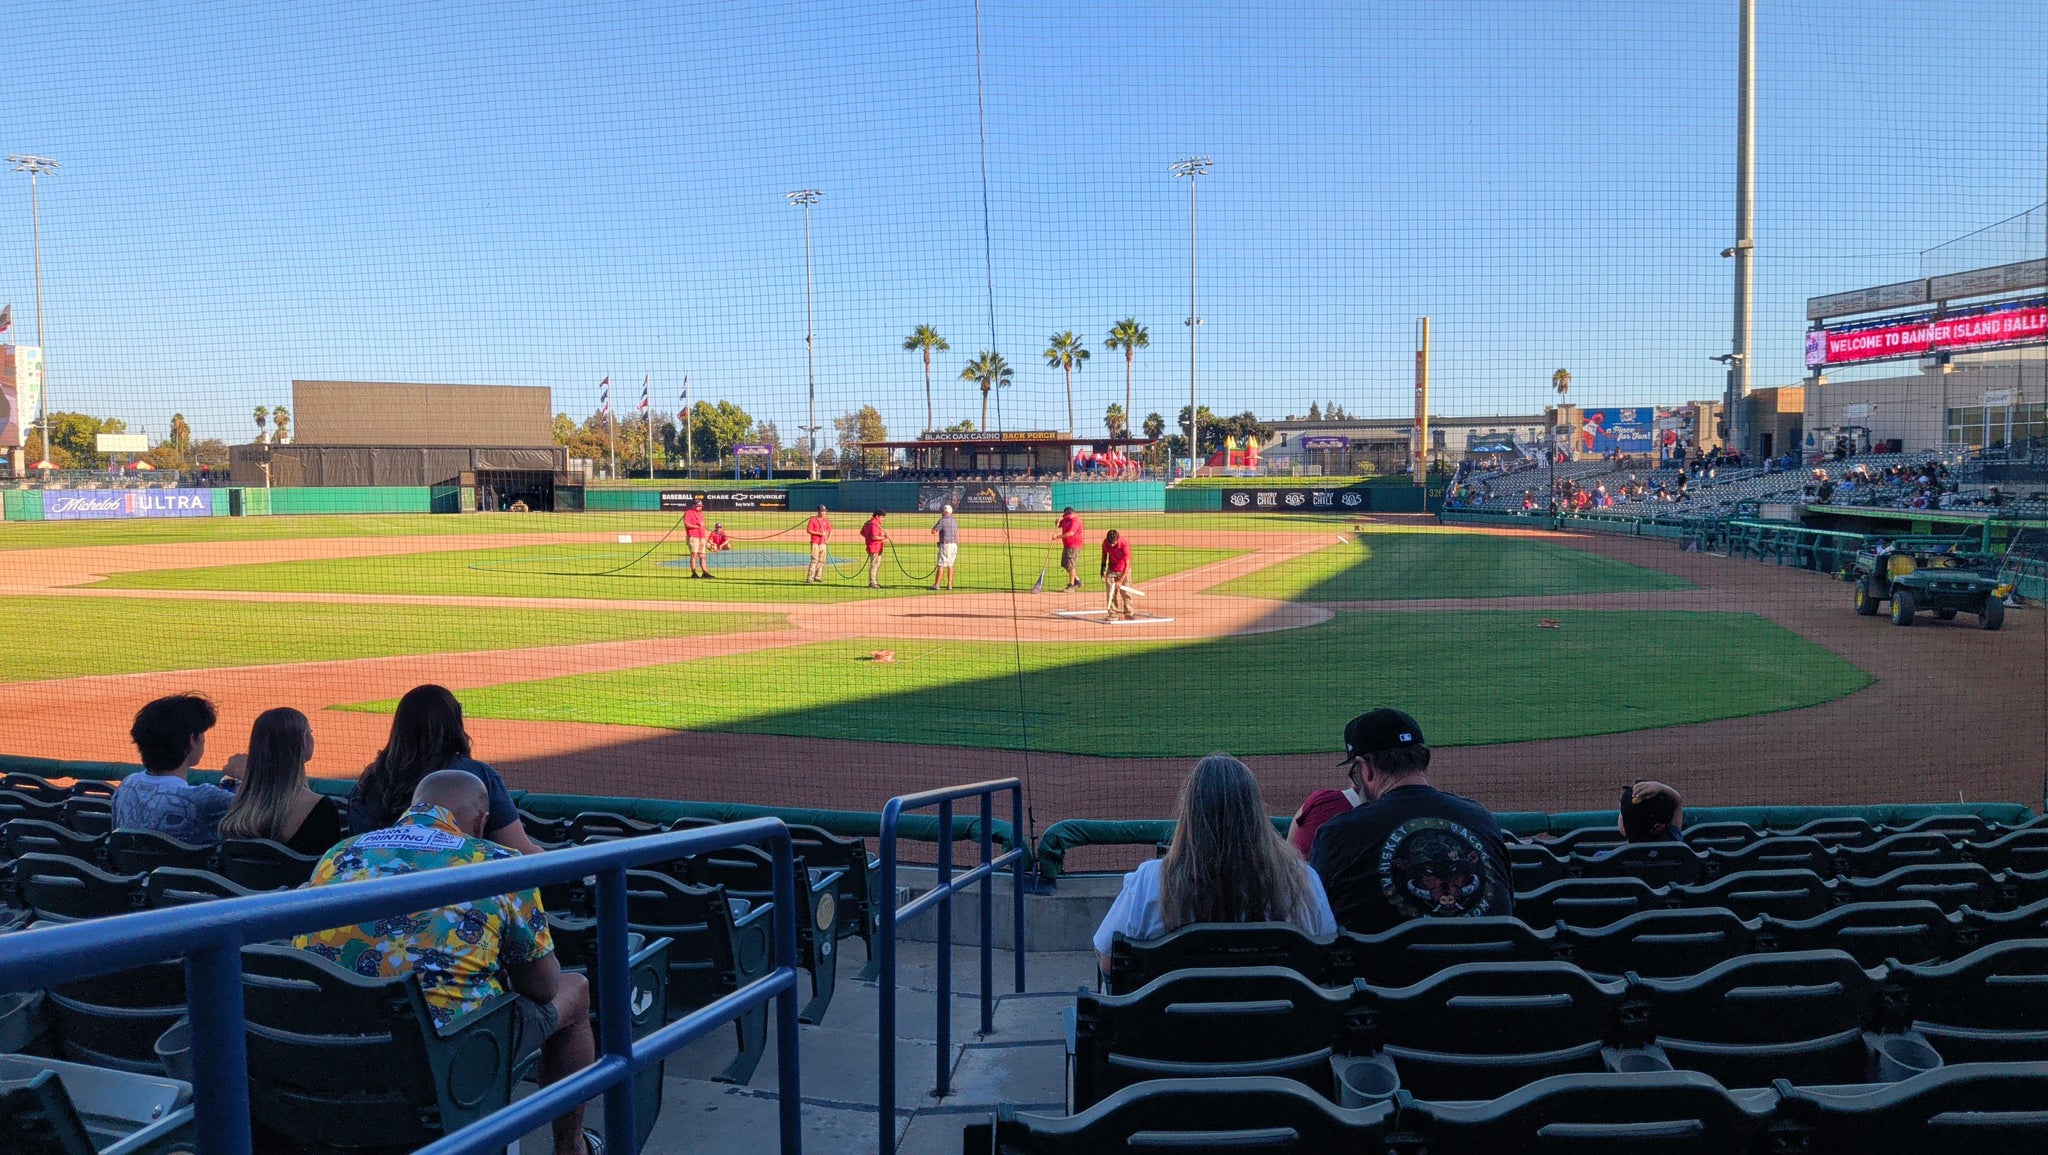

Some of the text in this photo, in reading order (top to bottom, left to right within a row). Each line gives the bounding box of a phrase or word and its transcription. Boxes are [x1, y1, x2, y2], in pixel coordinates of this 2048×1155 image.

[1830, 334, 1883, 353] WELCOME
[1885, 332, 1899, 345] TO
[1901, 324, 1950, 345] BANNER
[1953, 319, 2000, 339] ISLAND
[1612, 425, 1636, 434] Place
[925, 432, 1056, 441] BLACK OAK CASINO BACK PORCH
[1617, 432, 1651, 442] for Fun!
[52, 495, 205, 513] Michelob ULTRA
[1230, 494, 1250, 505] 805
[1257, 496, 1277, 505] CHILL
[1285, 494, 1305, 505] 805
[1312, 496, 1334, 505] CHILL
[1341, 494, 1362, 505] 805
[364, 833, 425, 842] PRINTING
[1450, 823, 1490, 861] BACON
[1380, 825, 1408, 888] WHISKEY
